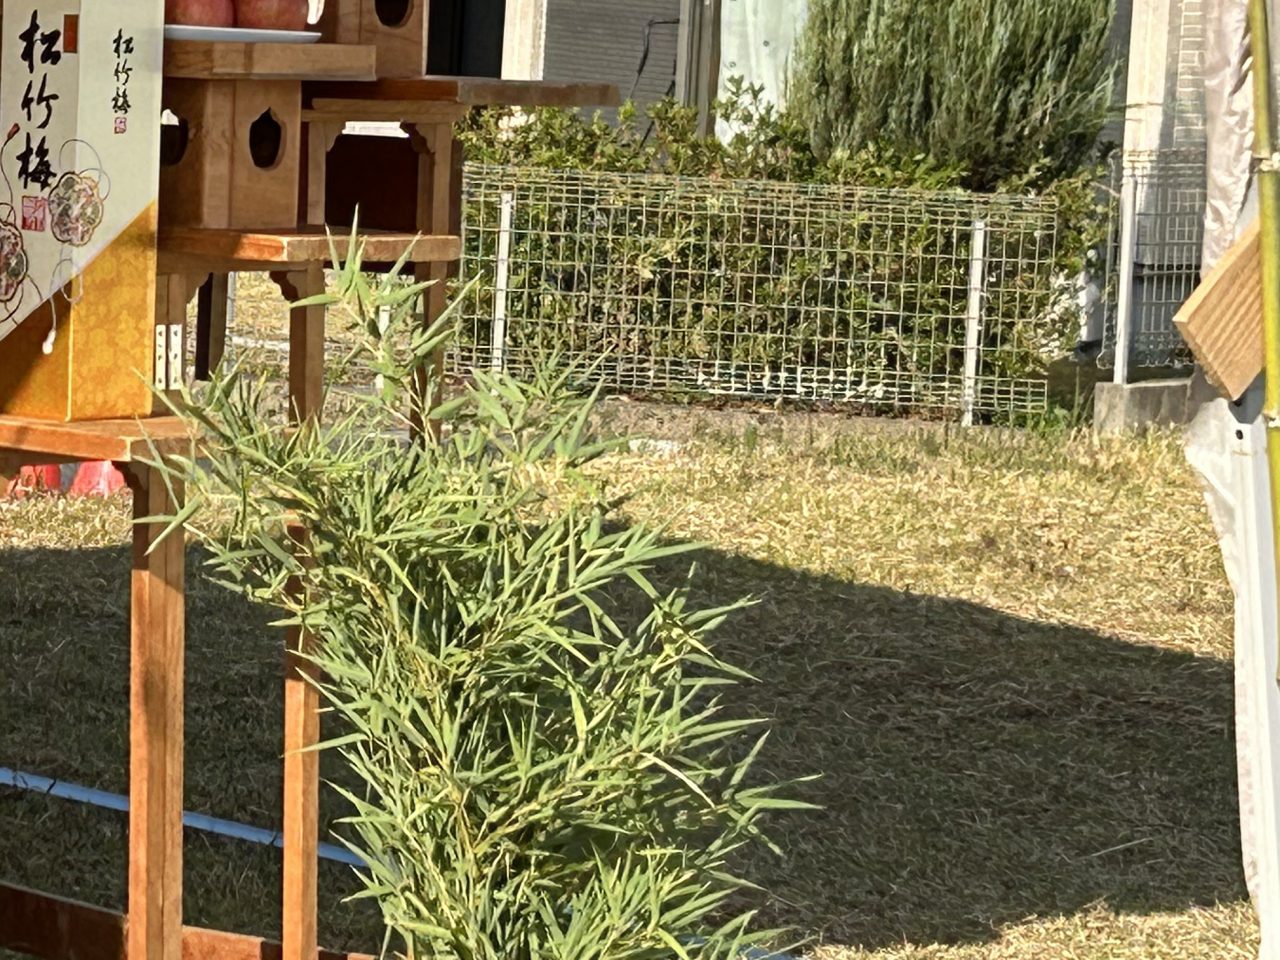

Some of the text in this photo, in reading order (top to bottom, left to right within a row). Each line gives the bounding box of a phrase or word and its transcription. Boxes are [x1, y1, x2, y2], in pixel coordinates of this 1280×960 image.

[16, 9, 62, 191] 松竹梅
[111, 27, 134, 115] 松竹梅
